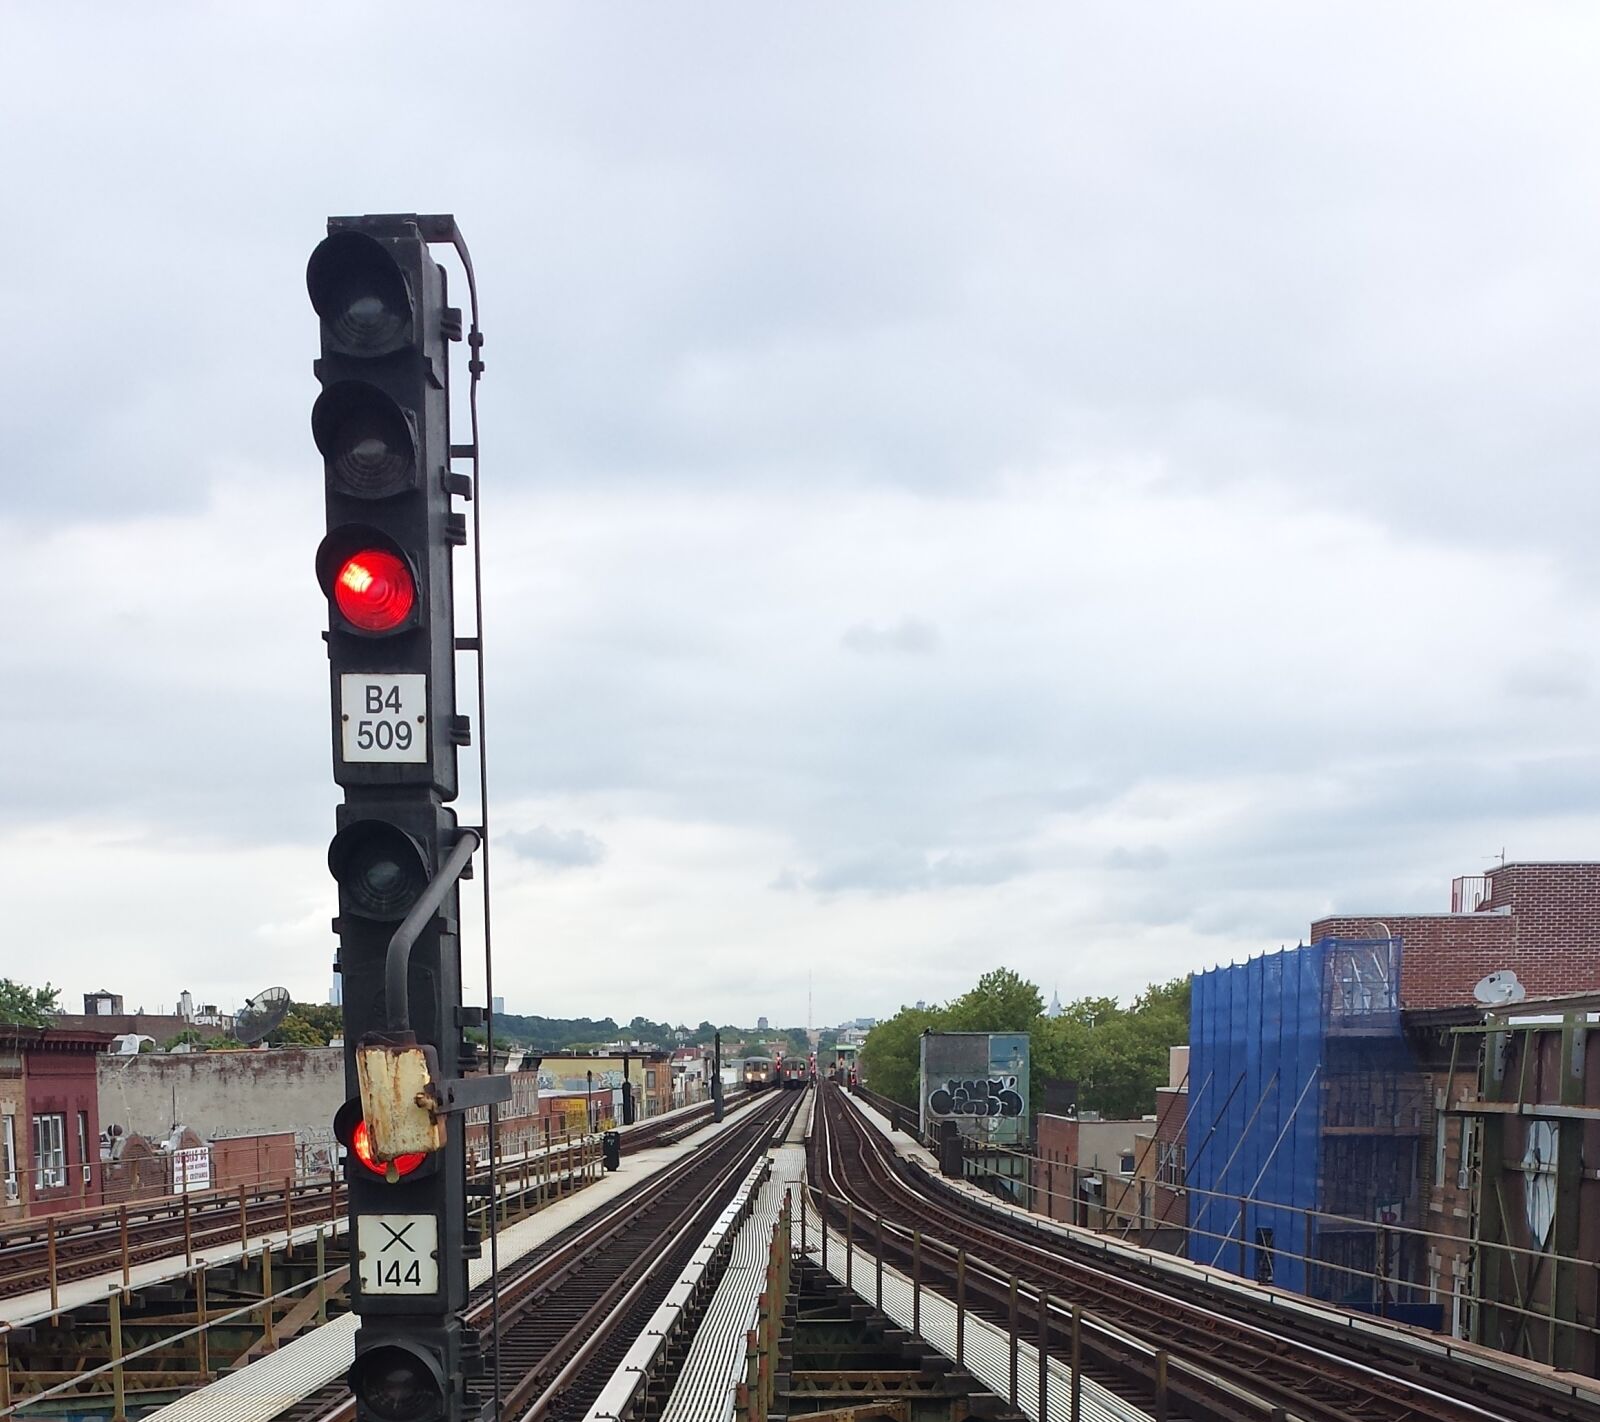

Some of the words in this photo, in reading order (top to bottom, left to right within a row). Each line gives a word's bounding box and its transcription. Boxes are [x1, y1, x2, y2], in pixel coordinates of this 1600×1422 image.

[366, 686, 402, 714] B4
[357, 721, 413, 750] 509
[380, 1222, 415, 1252] X
[377, 1260, 421, 1287] 144
